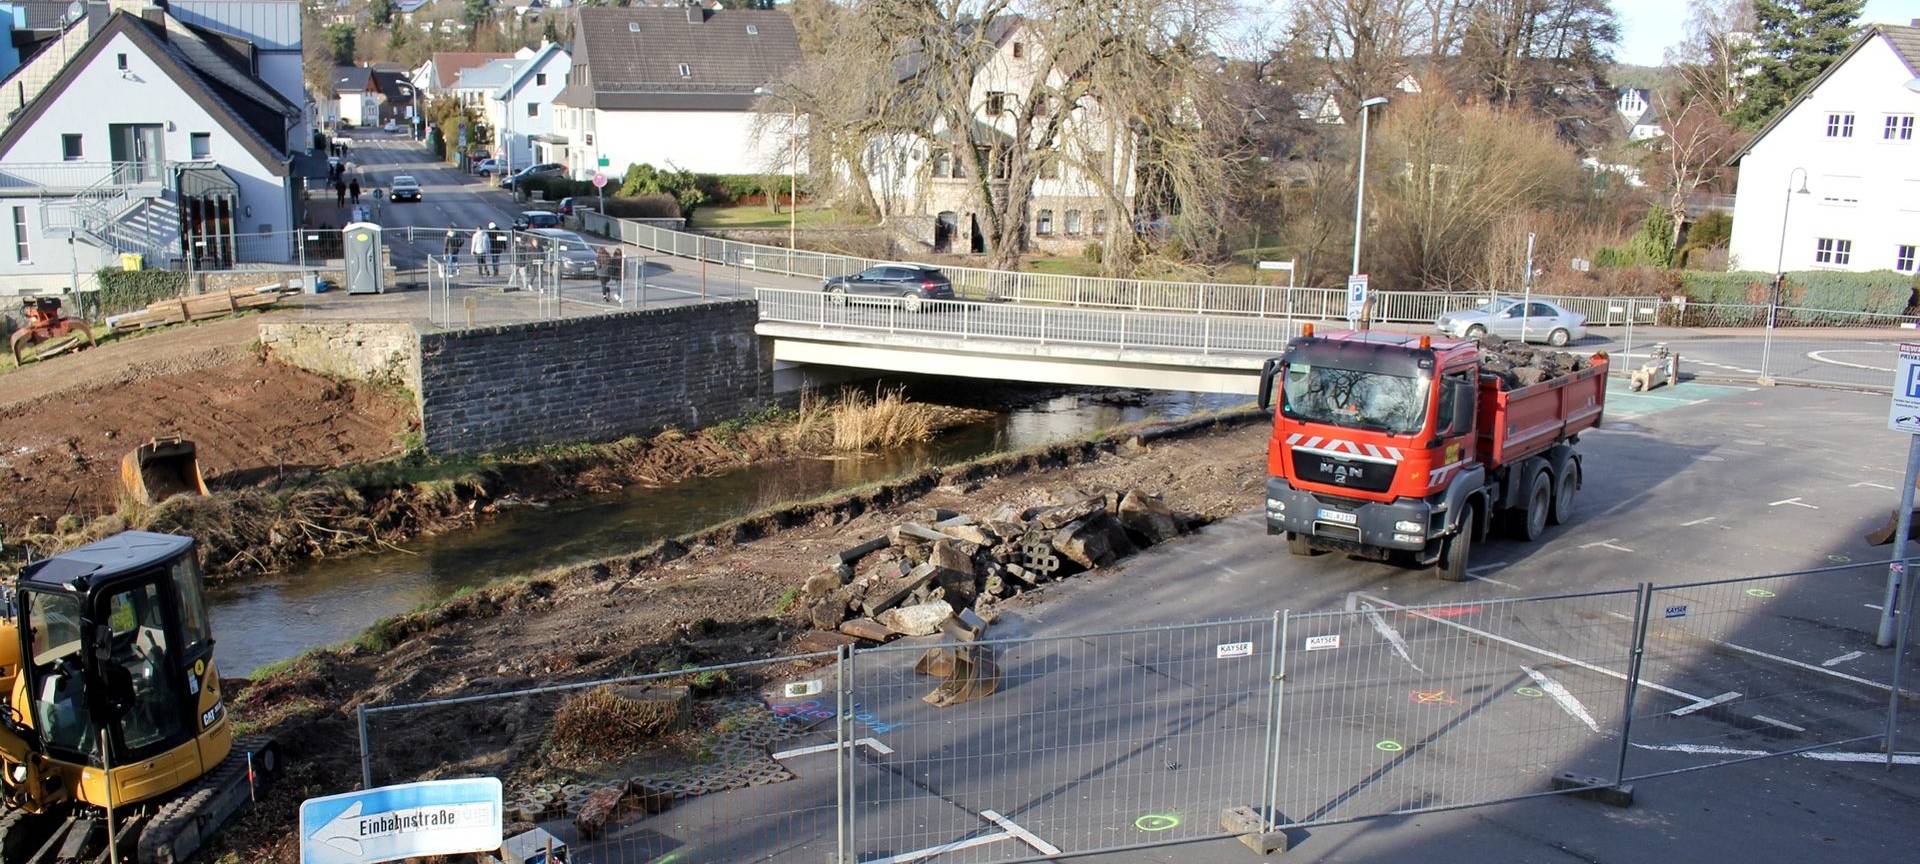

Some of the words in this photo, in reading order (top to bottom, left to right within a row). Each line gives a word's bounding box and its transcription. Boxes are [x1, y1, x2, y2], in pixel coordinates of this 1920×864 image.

[1320, 463, 1363, 478] MAN
[1311, 636, 1337, 644] KAYSER
[1221, 643, 1248, 652] KAYSER
[359, 810, 455, 836] Einbahnstraße
